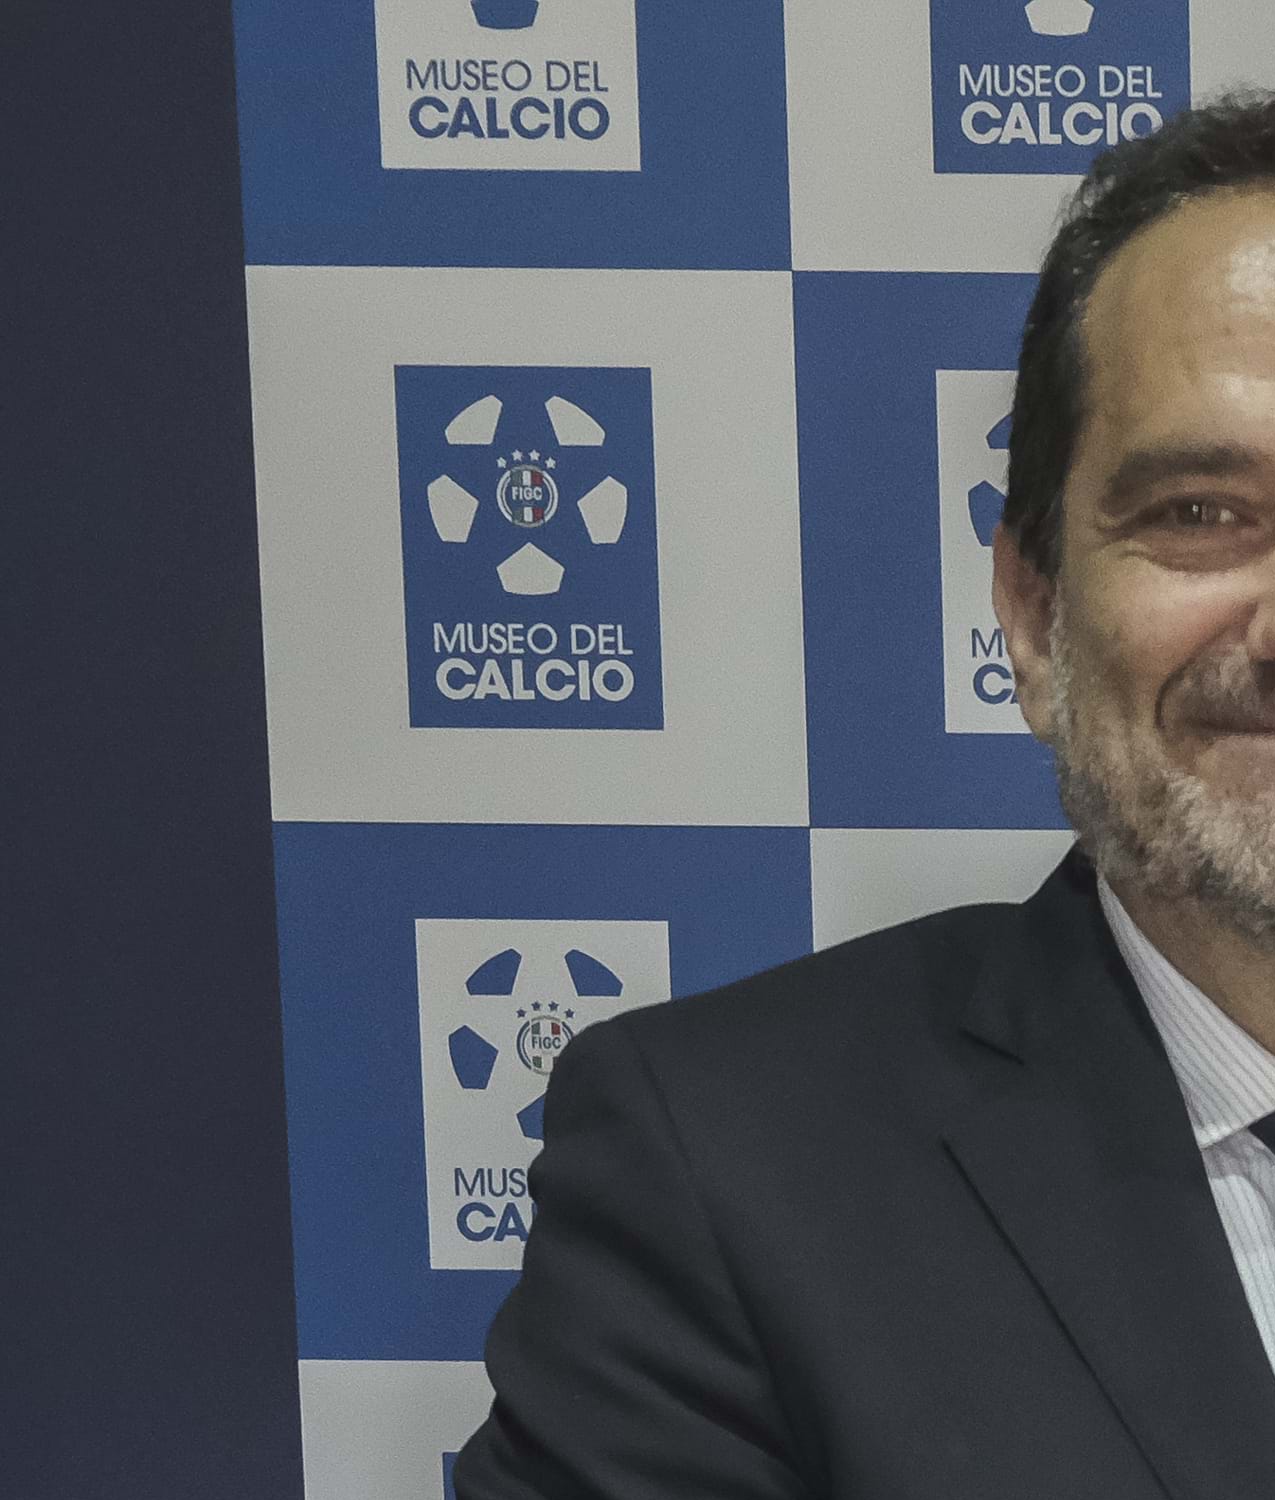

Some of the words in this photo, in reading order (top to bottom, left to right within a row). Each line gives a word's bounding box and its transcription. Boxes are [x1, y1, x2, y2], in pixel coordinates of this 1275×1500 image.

[405, 59, 532, 91] MUSEO
[545, 61, 608, 92] DEL
[959, 64, 1086, 97] MUSEO
[1099, 65, 1162, 98] DEL
[409, 96, 610, 140] CALCIO
[961, 101, 1164, 146] CALCIO
[511, 486, 543, 500] FIGC
[433, 622, 558, 655] MUSEO
[571, 623, 634, 655] DEL
[435, 658, 635, 702] CALCIO
[531, 1036, 562, 1050] FIGC
[454, 1167, 528, 1198] MUS
